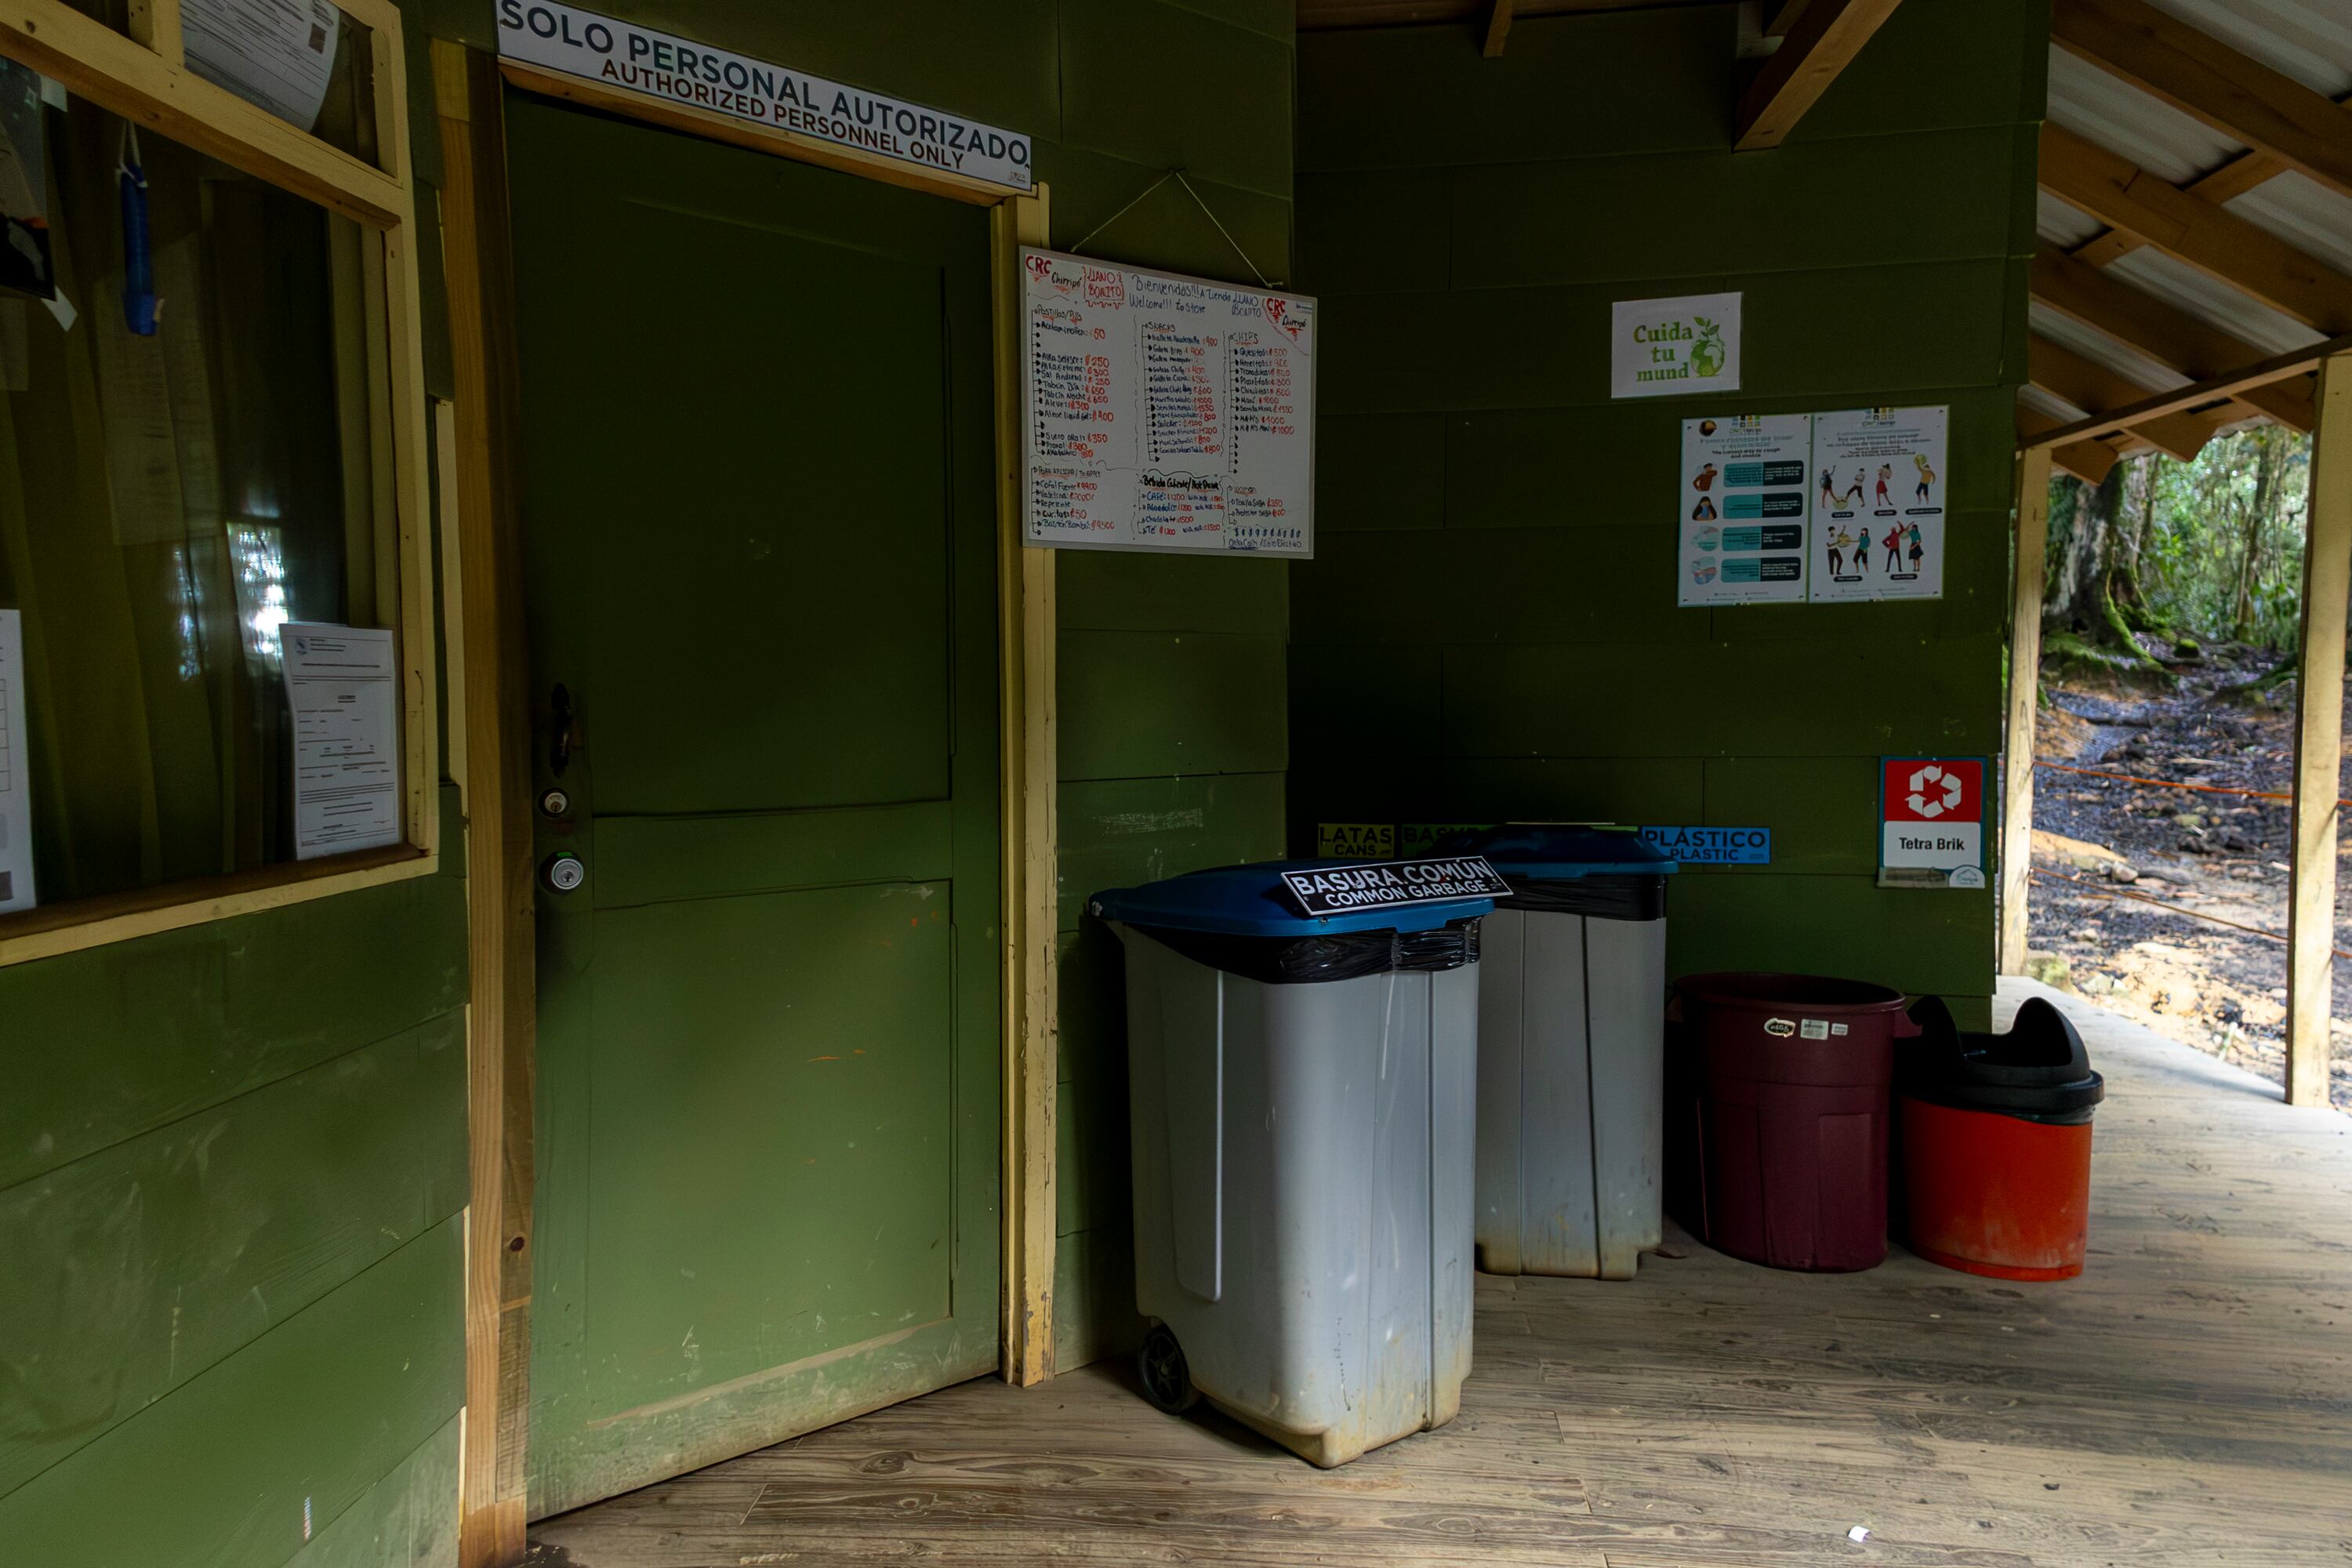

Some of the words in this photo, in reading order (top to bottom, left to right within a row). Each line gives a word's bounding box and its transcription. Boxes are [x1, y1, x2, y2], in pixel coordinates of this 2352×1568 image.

[500, 0, 613, 53] SOLO
[628, 33, 819, 111] PERSONAL
[831, 92, 1028, 165] AUTORIZADO
[601, 59, 765, 118] AUTHORIZED
[774, 104, 903, 154] PERSONNEL
[909, 141, 964, 169] ONLY
[1025, 256, 1052, 274] CRC
[1267, 298, 1286, 313] CRC
[1633, 321, 1693, 343] Cuida
[1651, 346, 1675, 363] tu
[1320, 827, 1392, 843] LATAS
[1646, 826, 1766, 848] PLÁSTICO
[1899, 837, 1932, 849] Tetra
[1937, 837, 1965, 851] Brik
[1334, 844, 1385, 855] CANS
[1670, 848, 1738, 860] PLASTIC
[1293, 869, 1399, 895] BASURA
[1402, 858, 1499, 884] COMÚN
[1325, 887, 1408, 907] COMMON
[1410, 878, 1497, 899] GARBAGE
